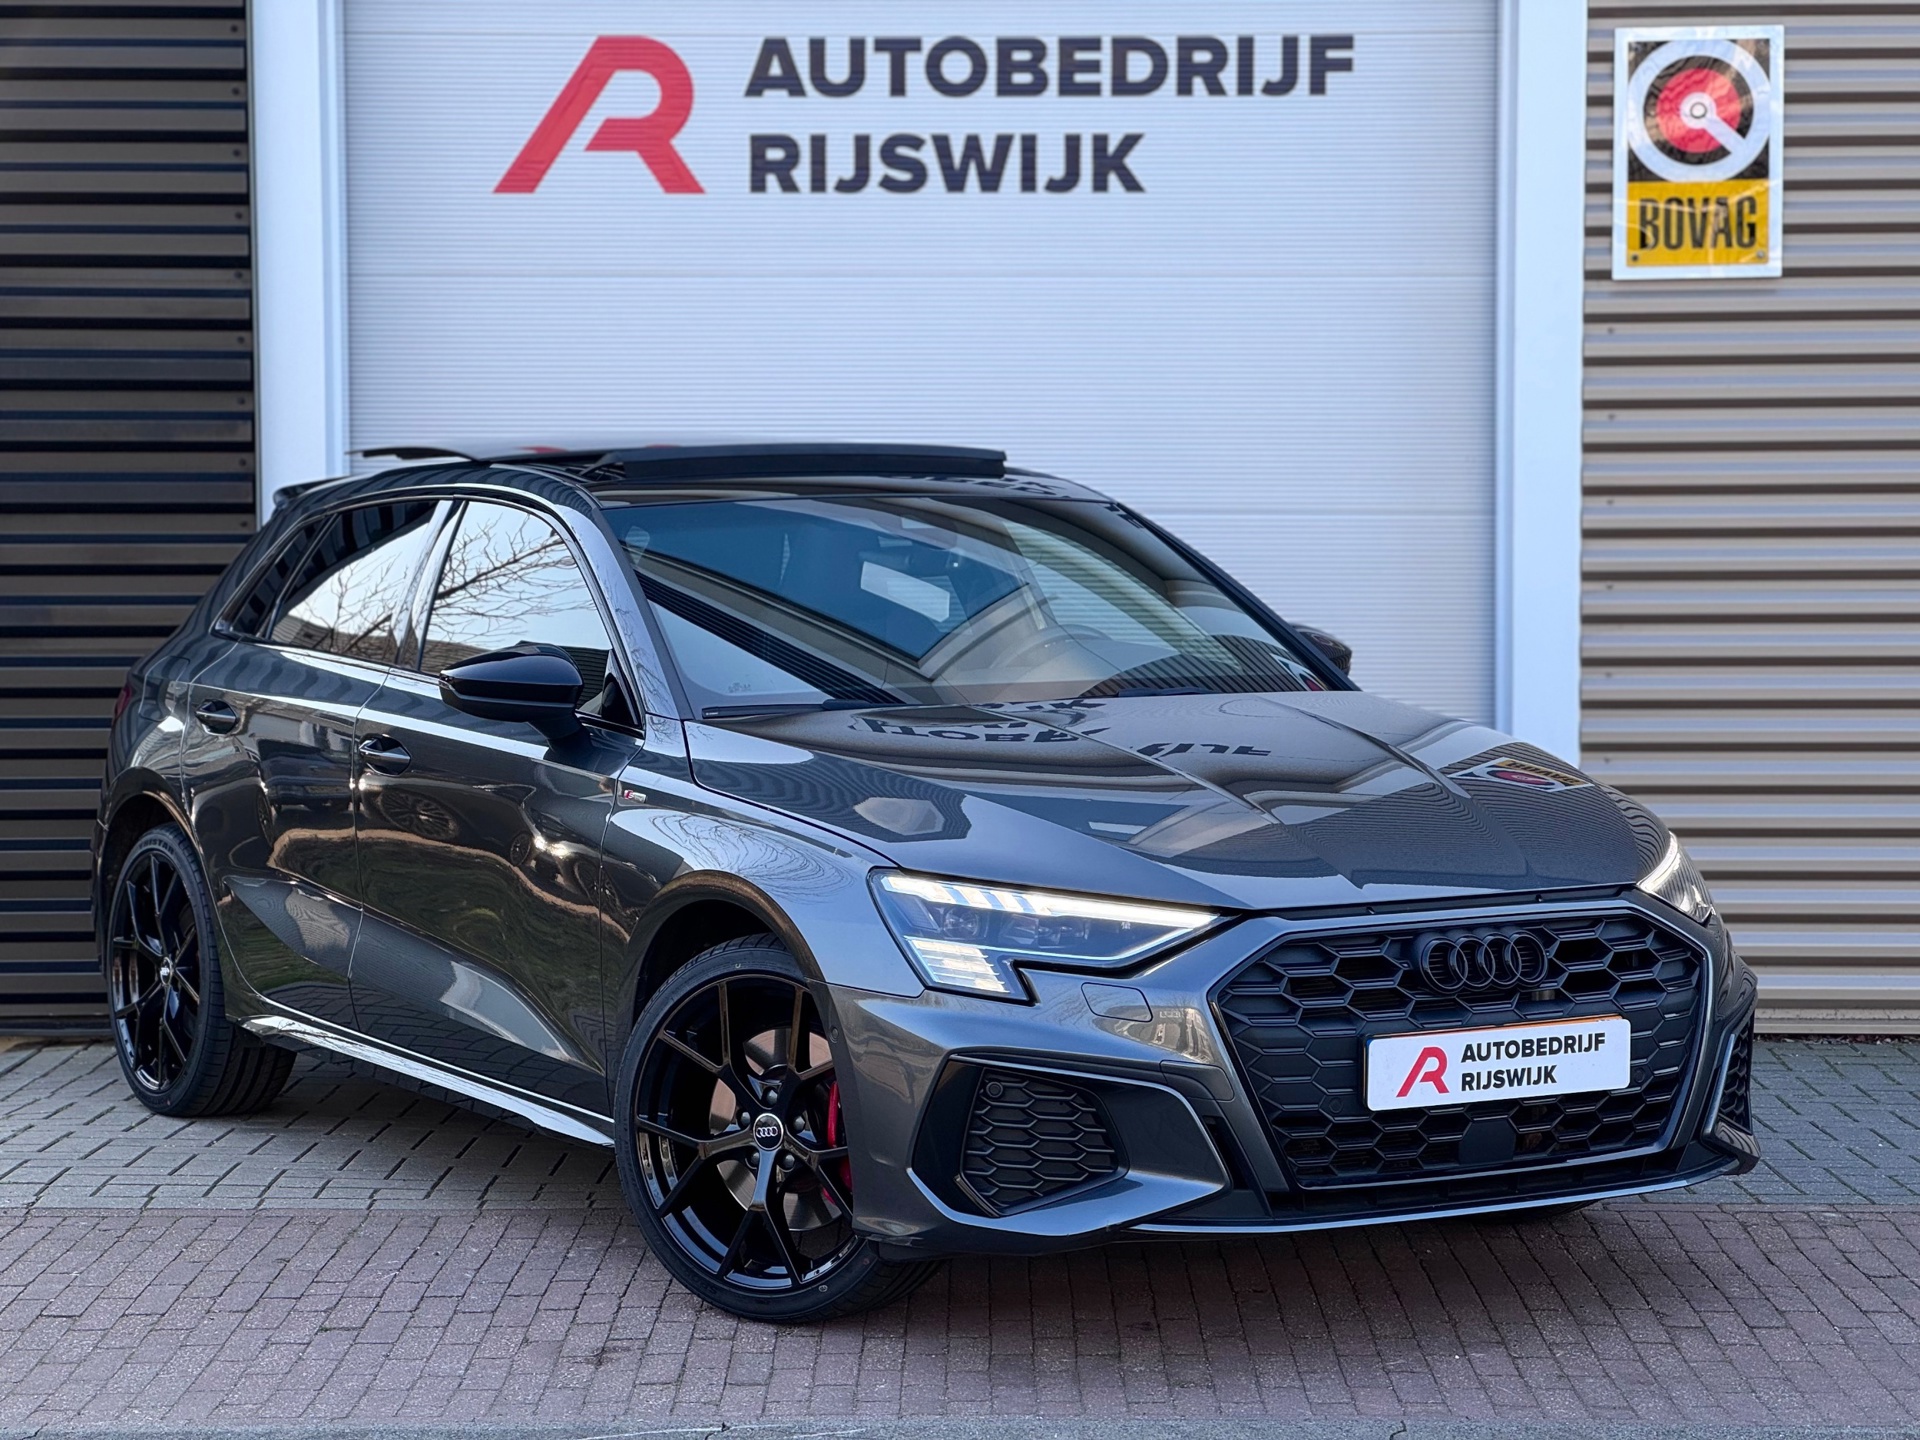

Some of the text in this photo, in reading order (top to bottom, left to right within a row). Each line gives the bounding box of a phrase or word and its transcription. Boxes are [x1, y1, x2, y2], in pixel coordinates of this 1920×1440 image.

[744, 35, 1355, 97] AUTOBEDRIJF
[749, 134, 1147, 195] RIJSWIJK
[1639, 195, 1758, 250] BOVAG
[1460, 1032, 1606, 1063] AUTOBEDRIJF
[1460, 1064, 1557, 1092] RIJSWIJK
